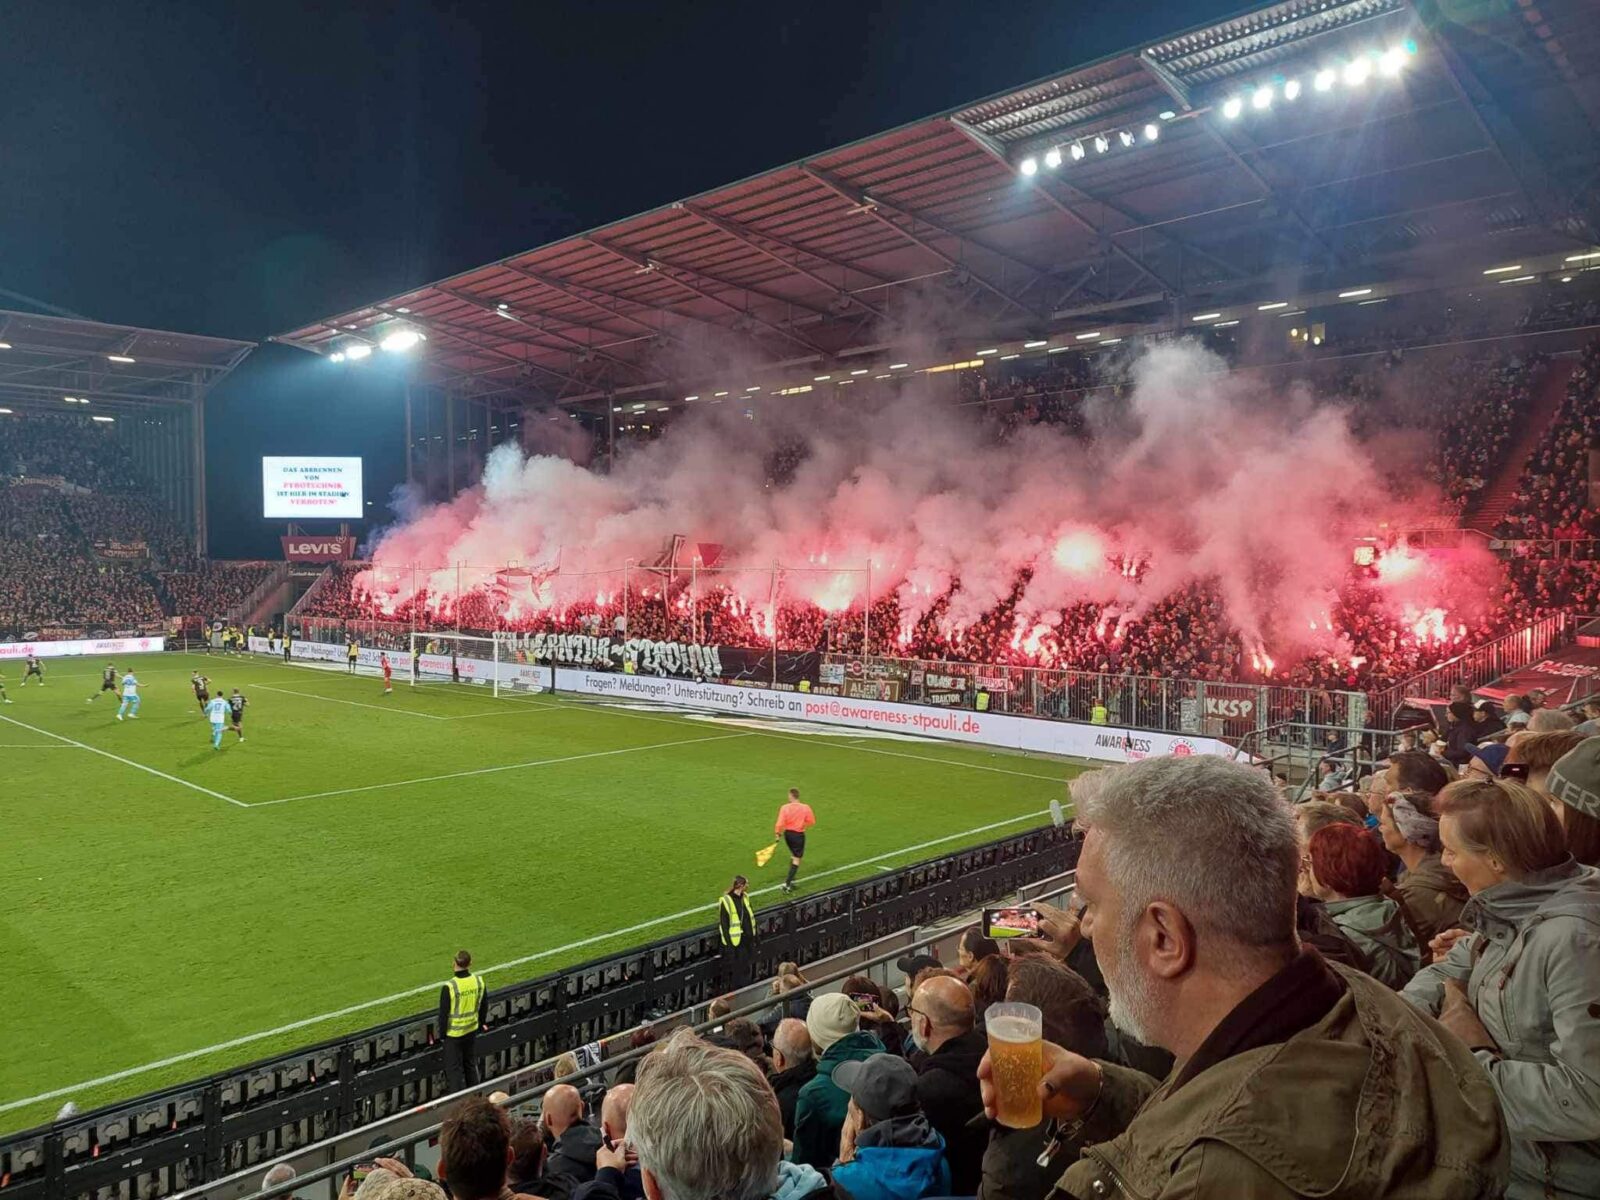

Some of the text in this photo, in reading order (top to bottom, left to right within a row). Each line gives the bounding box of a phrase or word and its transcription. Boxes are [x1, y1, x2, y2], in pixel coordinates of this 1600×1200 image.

[850, 682, 892, 694] ALERA
[585, 675, 617, 692] Fragen?
[619, 678, 671, 698] Meldungen?
[674, 683, 744, 708] Unterstützung?
[747, 691, 785, 710] Schreib
[788, 699, 802, 712] an
[805, 700, 981, 734] post@awareness-stpauli.de
[931, 693, 961, 704] TRAKTOR
[1206, 697, 1253, 717] KKSP
